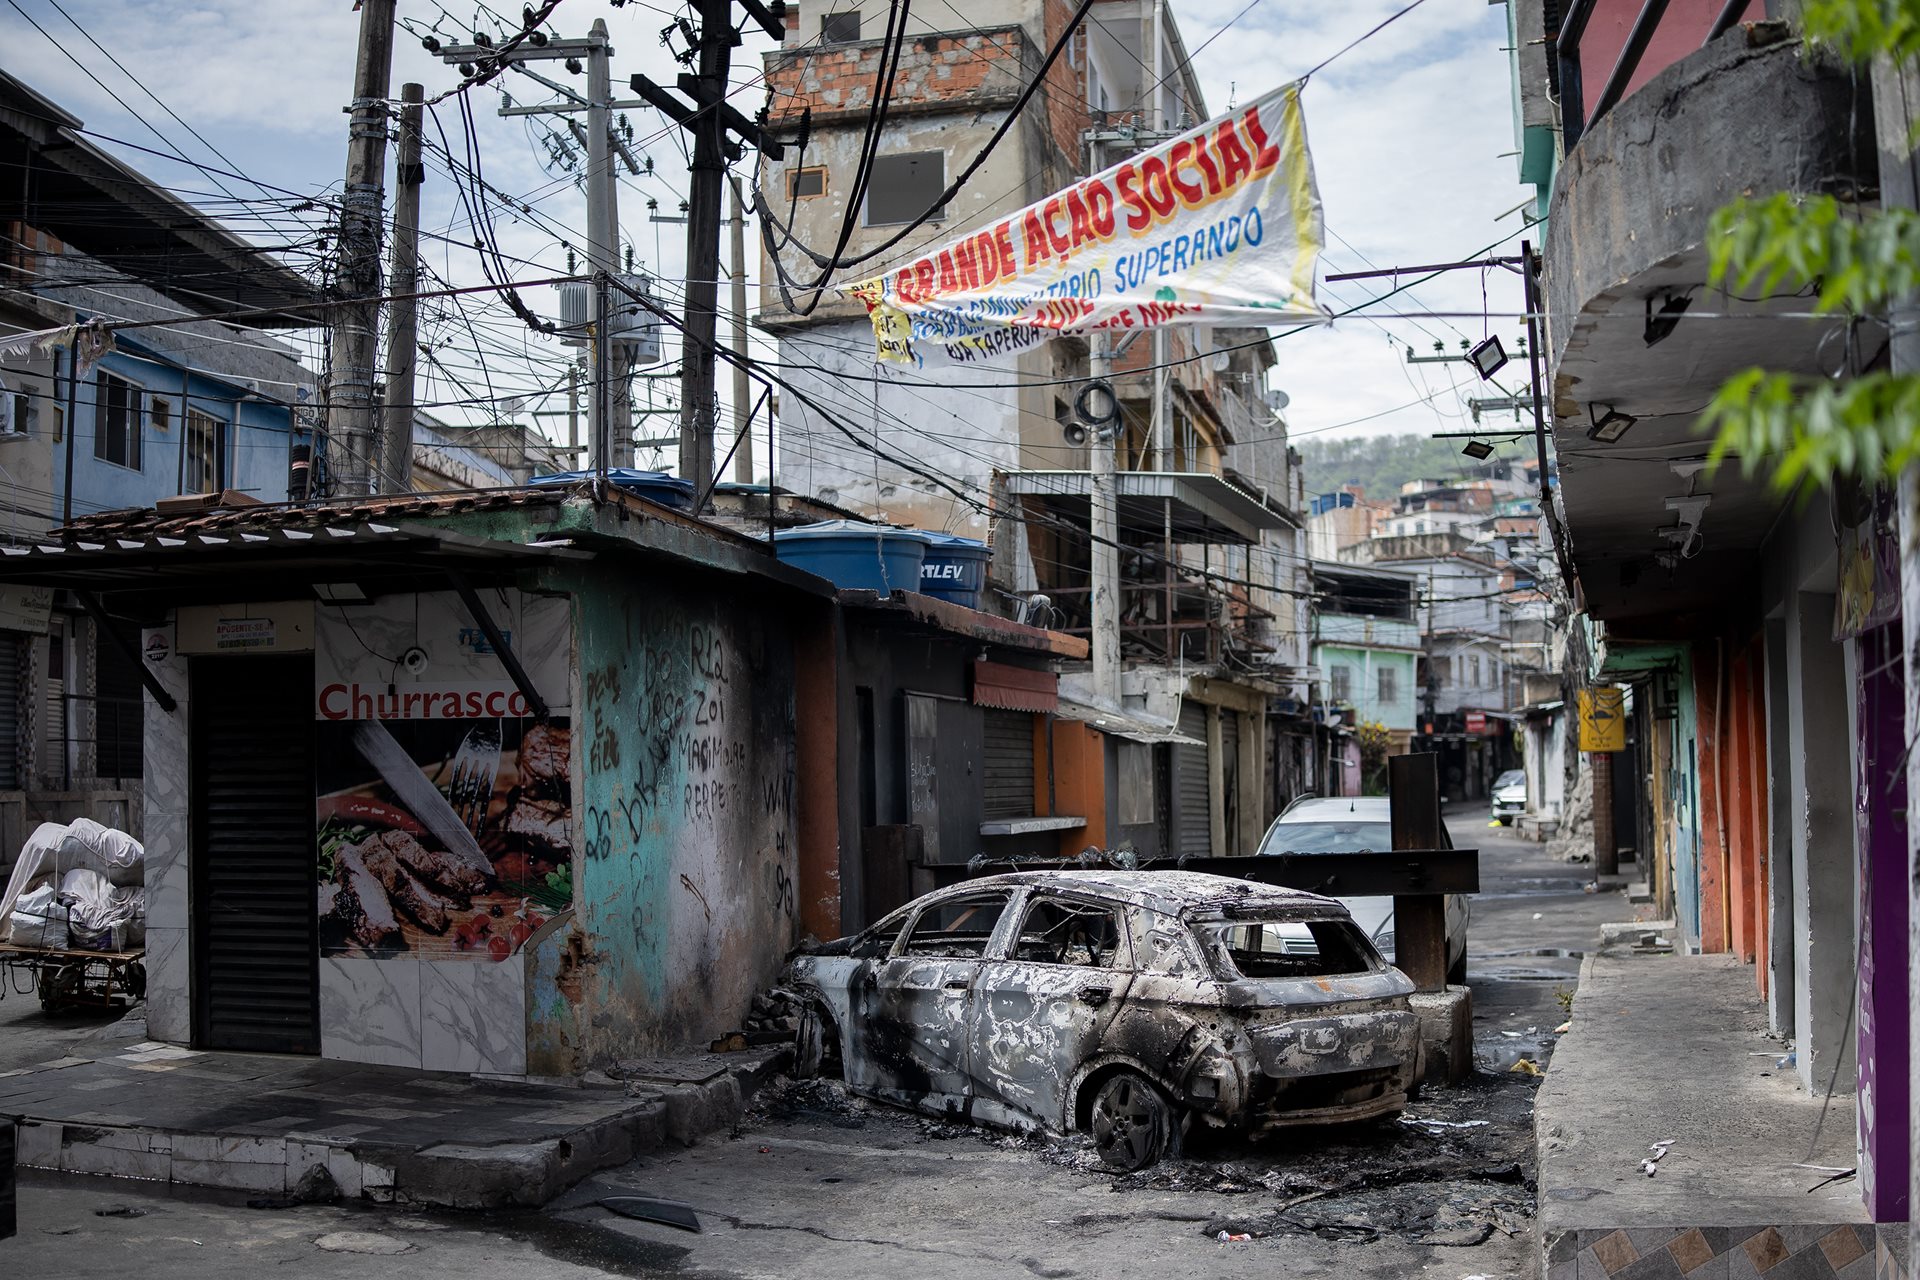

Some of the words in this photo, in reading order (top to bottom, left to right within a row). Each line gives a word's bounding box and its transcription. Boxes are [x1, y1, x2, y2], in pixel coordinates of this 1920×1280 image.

[895, 221, 1018, 303] GRANDE
[1024, 181, 1115, 264] AÇÃO
[1116, 105, 1281, 231] SOCIAL
[1114, 206, 1263, 293] SUPERANDO
[319, 684, 533, 720] Churrasco
